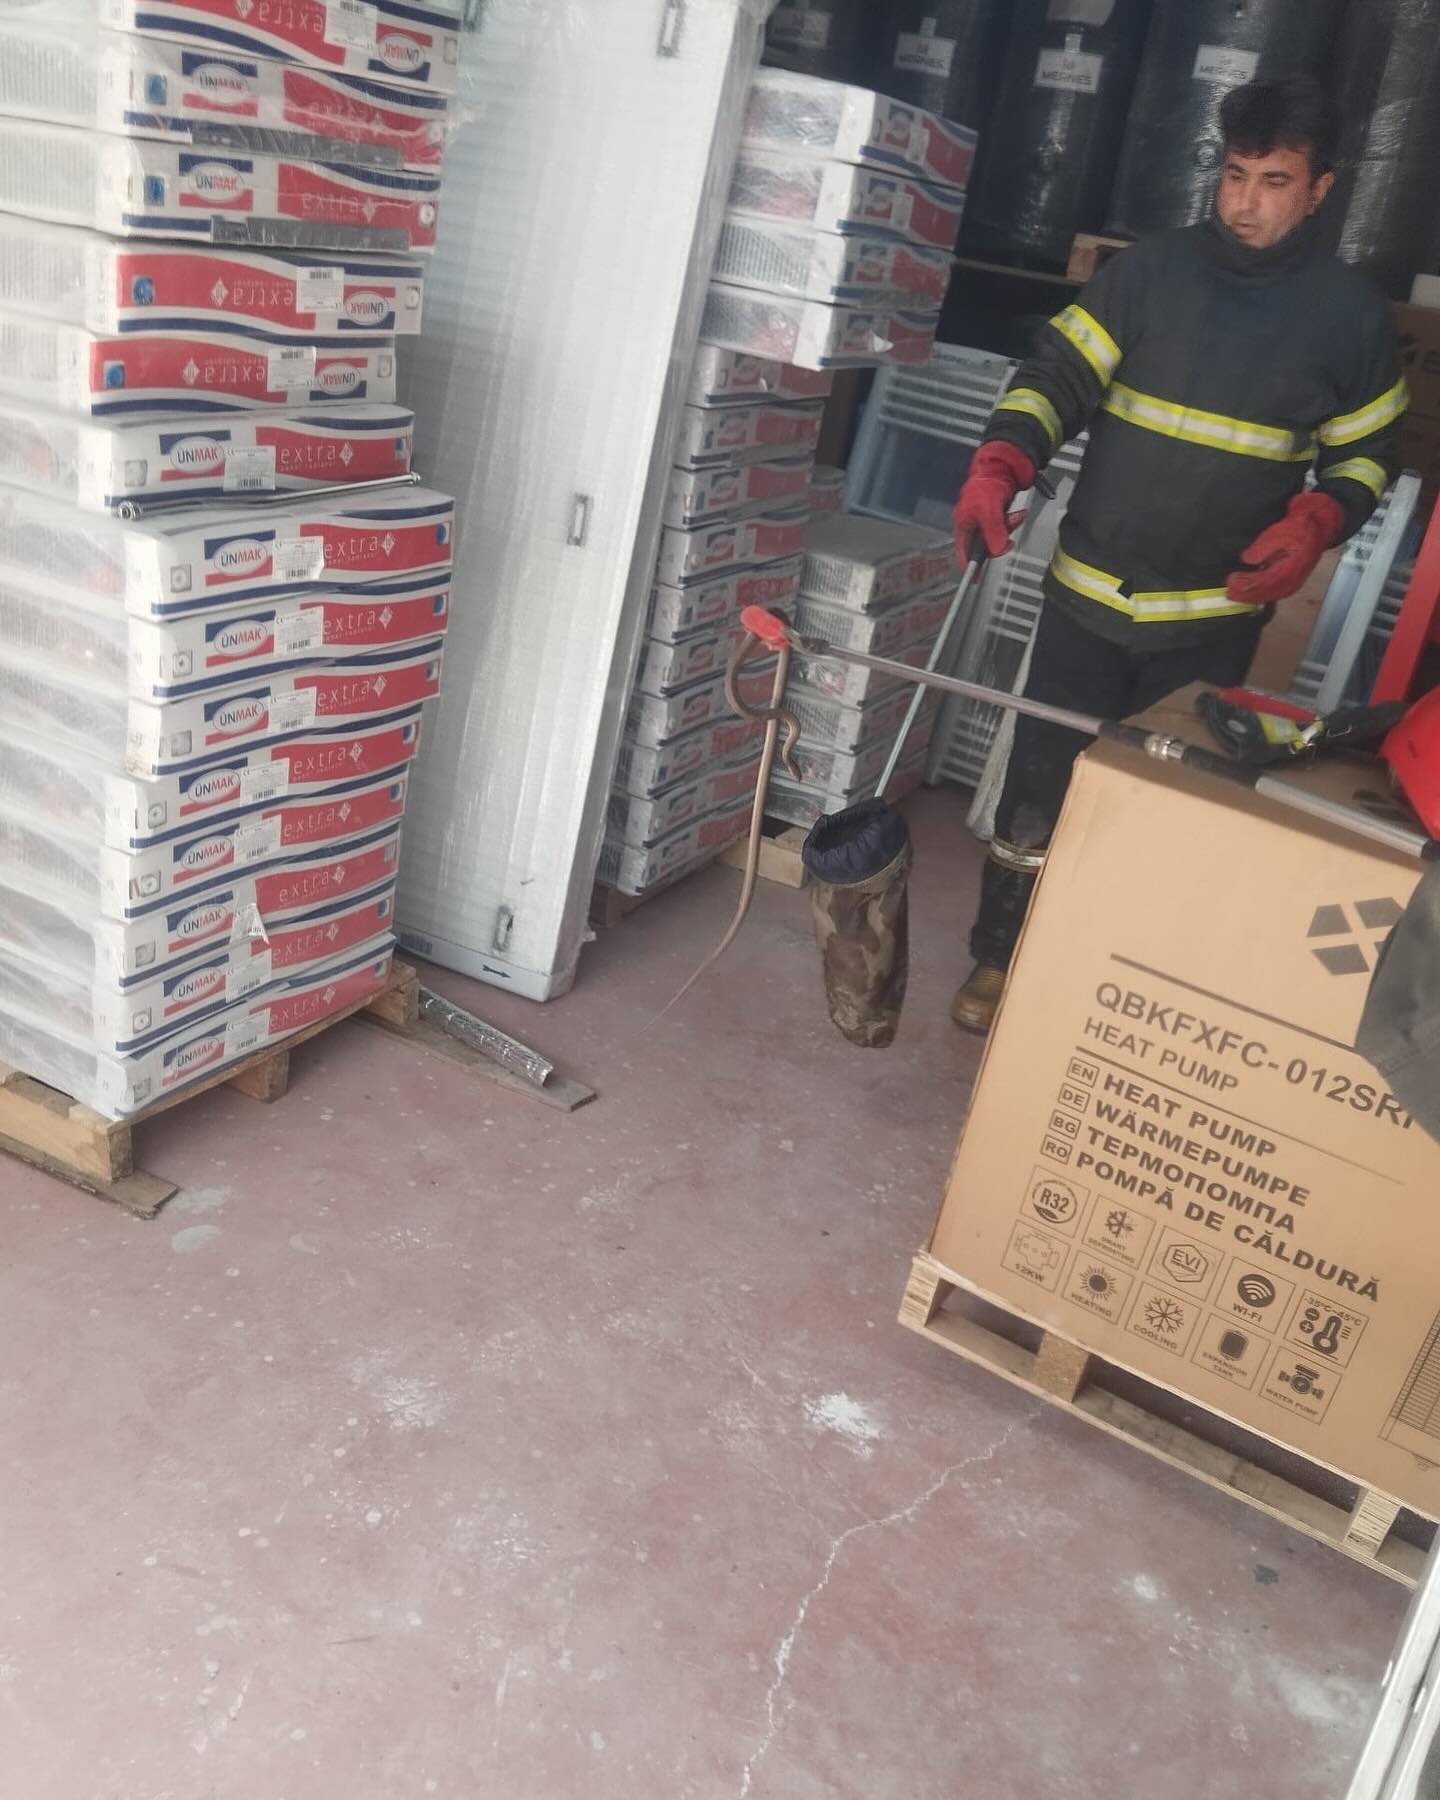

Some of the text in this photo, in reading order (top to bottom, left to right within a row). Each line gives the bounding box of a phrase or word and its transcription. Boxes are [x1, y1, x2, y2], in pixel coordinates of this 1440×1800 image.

[259, 3, 324, 33] extra
[233, 287, 293, 305] extra
[204, 365, 265, 383] extra
[280, 443, 336, 464] extra
[324, 536, 378, 559] extra
[323, 610, 376, 635] extra
[317, 680, 370, 707] extra
[293, 747, 346, 775] extra
[283, 807, 335, 837] extra
[279, 871, 329, 902] extra
[273, 929, 323, 960] extra
[1083, 1016, 1239, 1092] HEAT PUMP
[1071, 1063, 1277, 1158] EN HEAT PUMP
[1053, 1116, 1077, 1134] BG
[1062, 1089, 1311, 1207] DE WÄRMEPUMPE
[1039, 1188, 1070, 1214] R32
[1045, 1141, 1380, 1302] RO POMPĂ DE CĂLDURĂ
[1172, 1249, 1201, 1270] EVI
[1071, 1293, 1112, 1318] HEATING
[1233, 1303, 1263, 1323] WI-FI
[1133, 1324, 1178, 1350] COOLING
